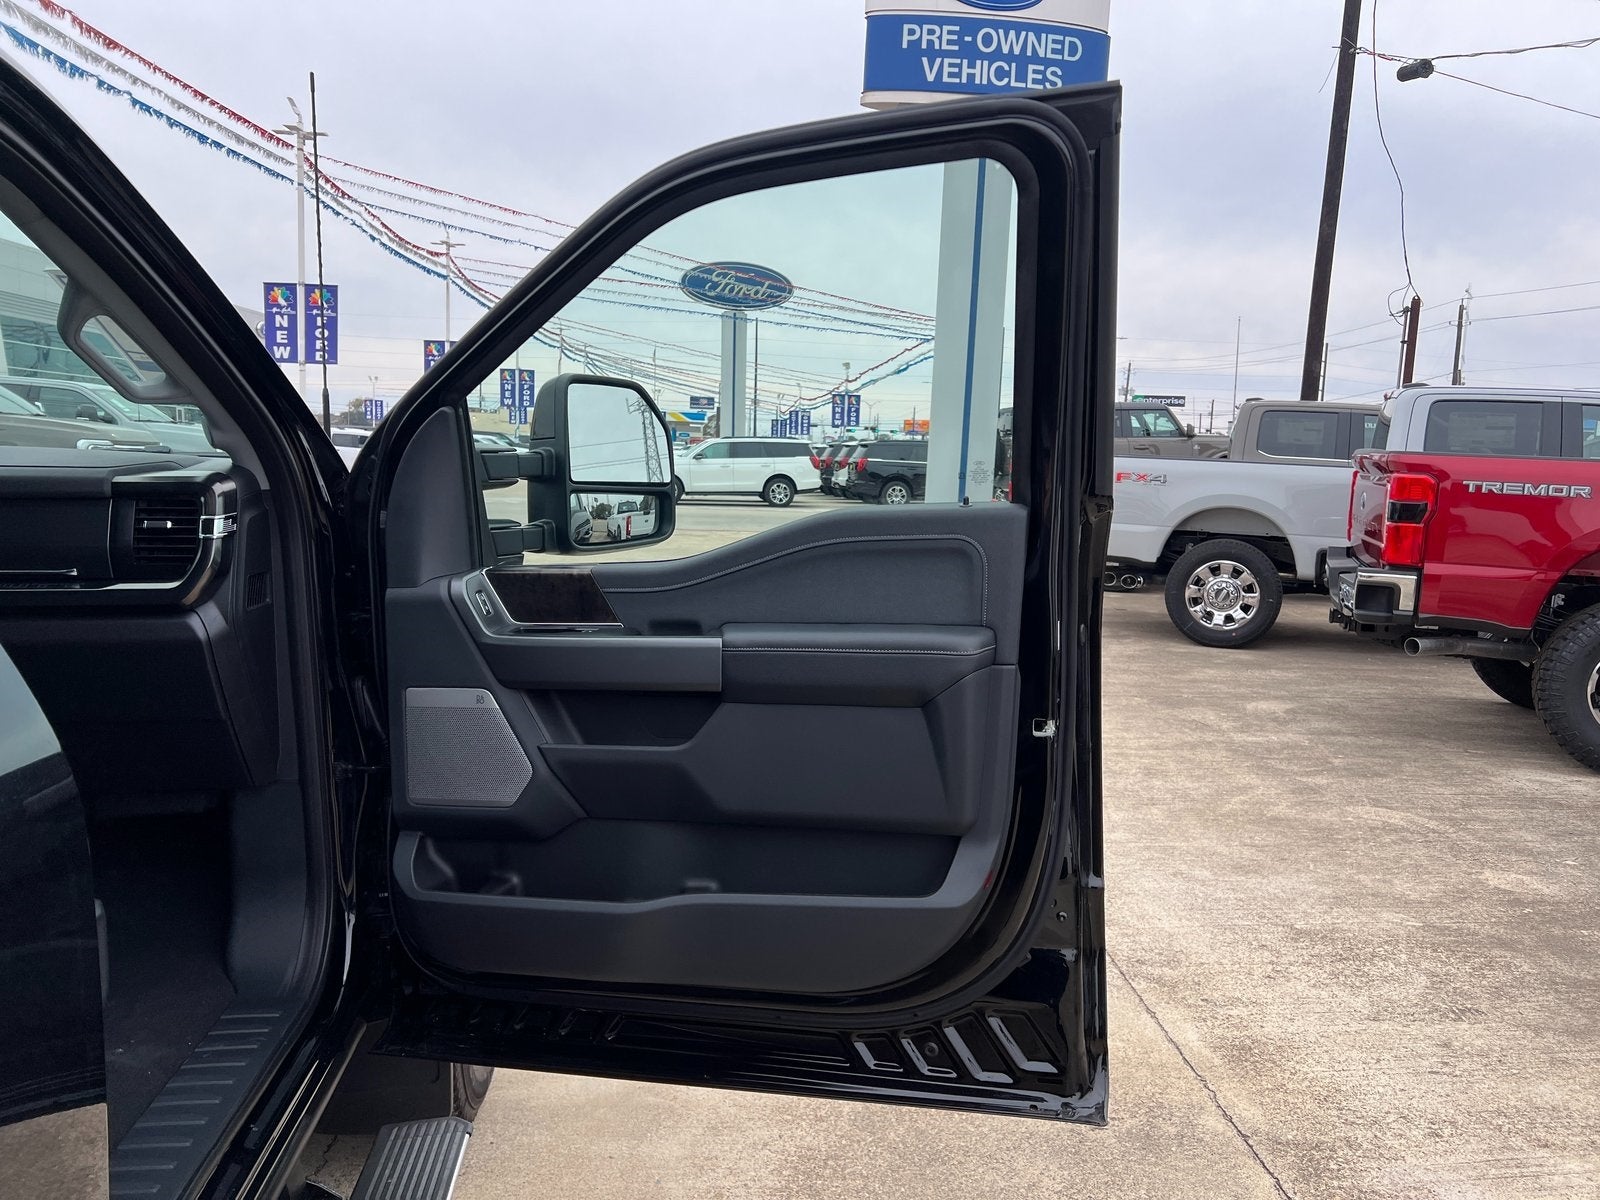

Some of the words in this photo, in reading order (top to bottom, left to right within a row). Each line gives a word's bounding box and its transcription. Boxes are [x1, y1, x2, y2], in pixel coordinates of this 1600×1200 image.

[921, 56, 1063, 90] VEHICLES
[705, 269, 770, 299] Ford
[273, 315, 291, 359] NEW
[314, 316, 329, 361] FORD
[503, 383, 512, 405] NEW
[523, 384, 531, 406] FORD
[834, 407, 842, 426] NEW
[1115, 472, 1168, 484] FX4
[1462, 479, 1593, 499] TREMOR
